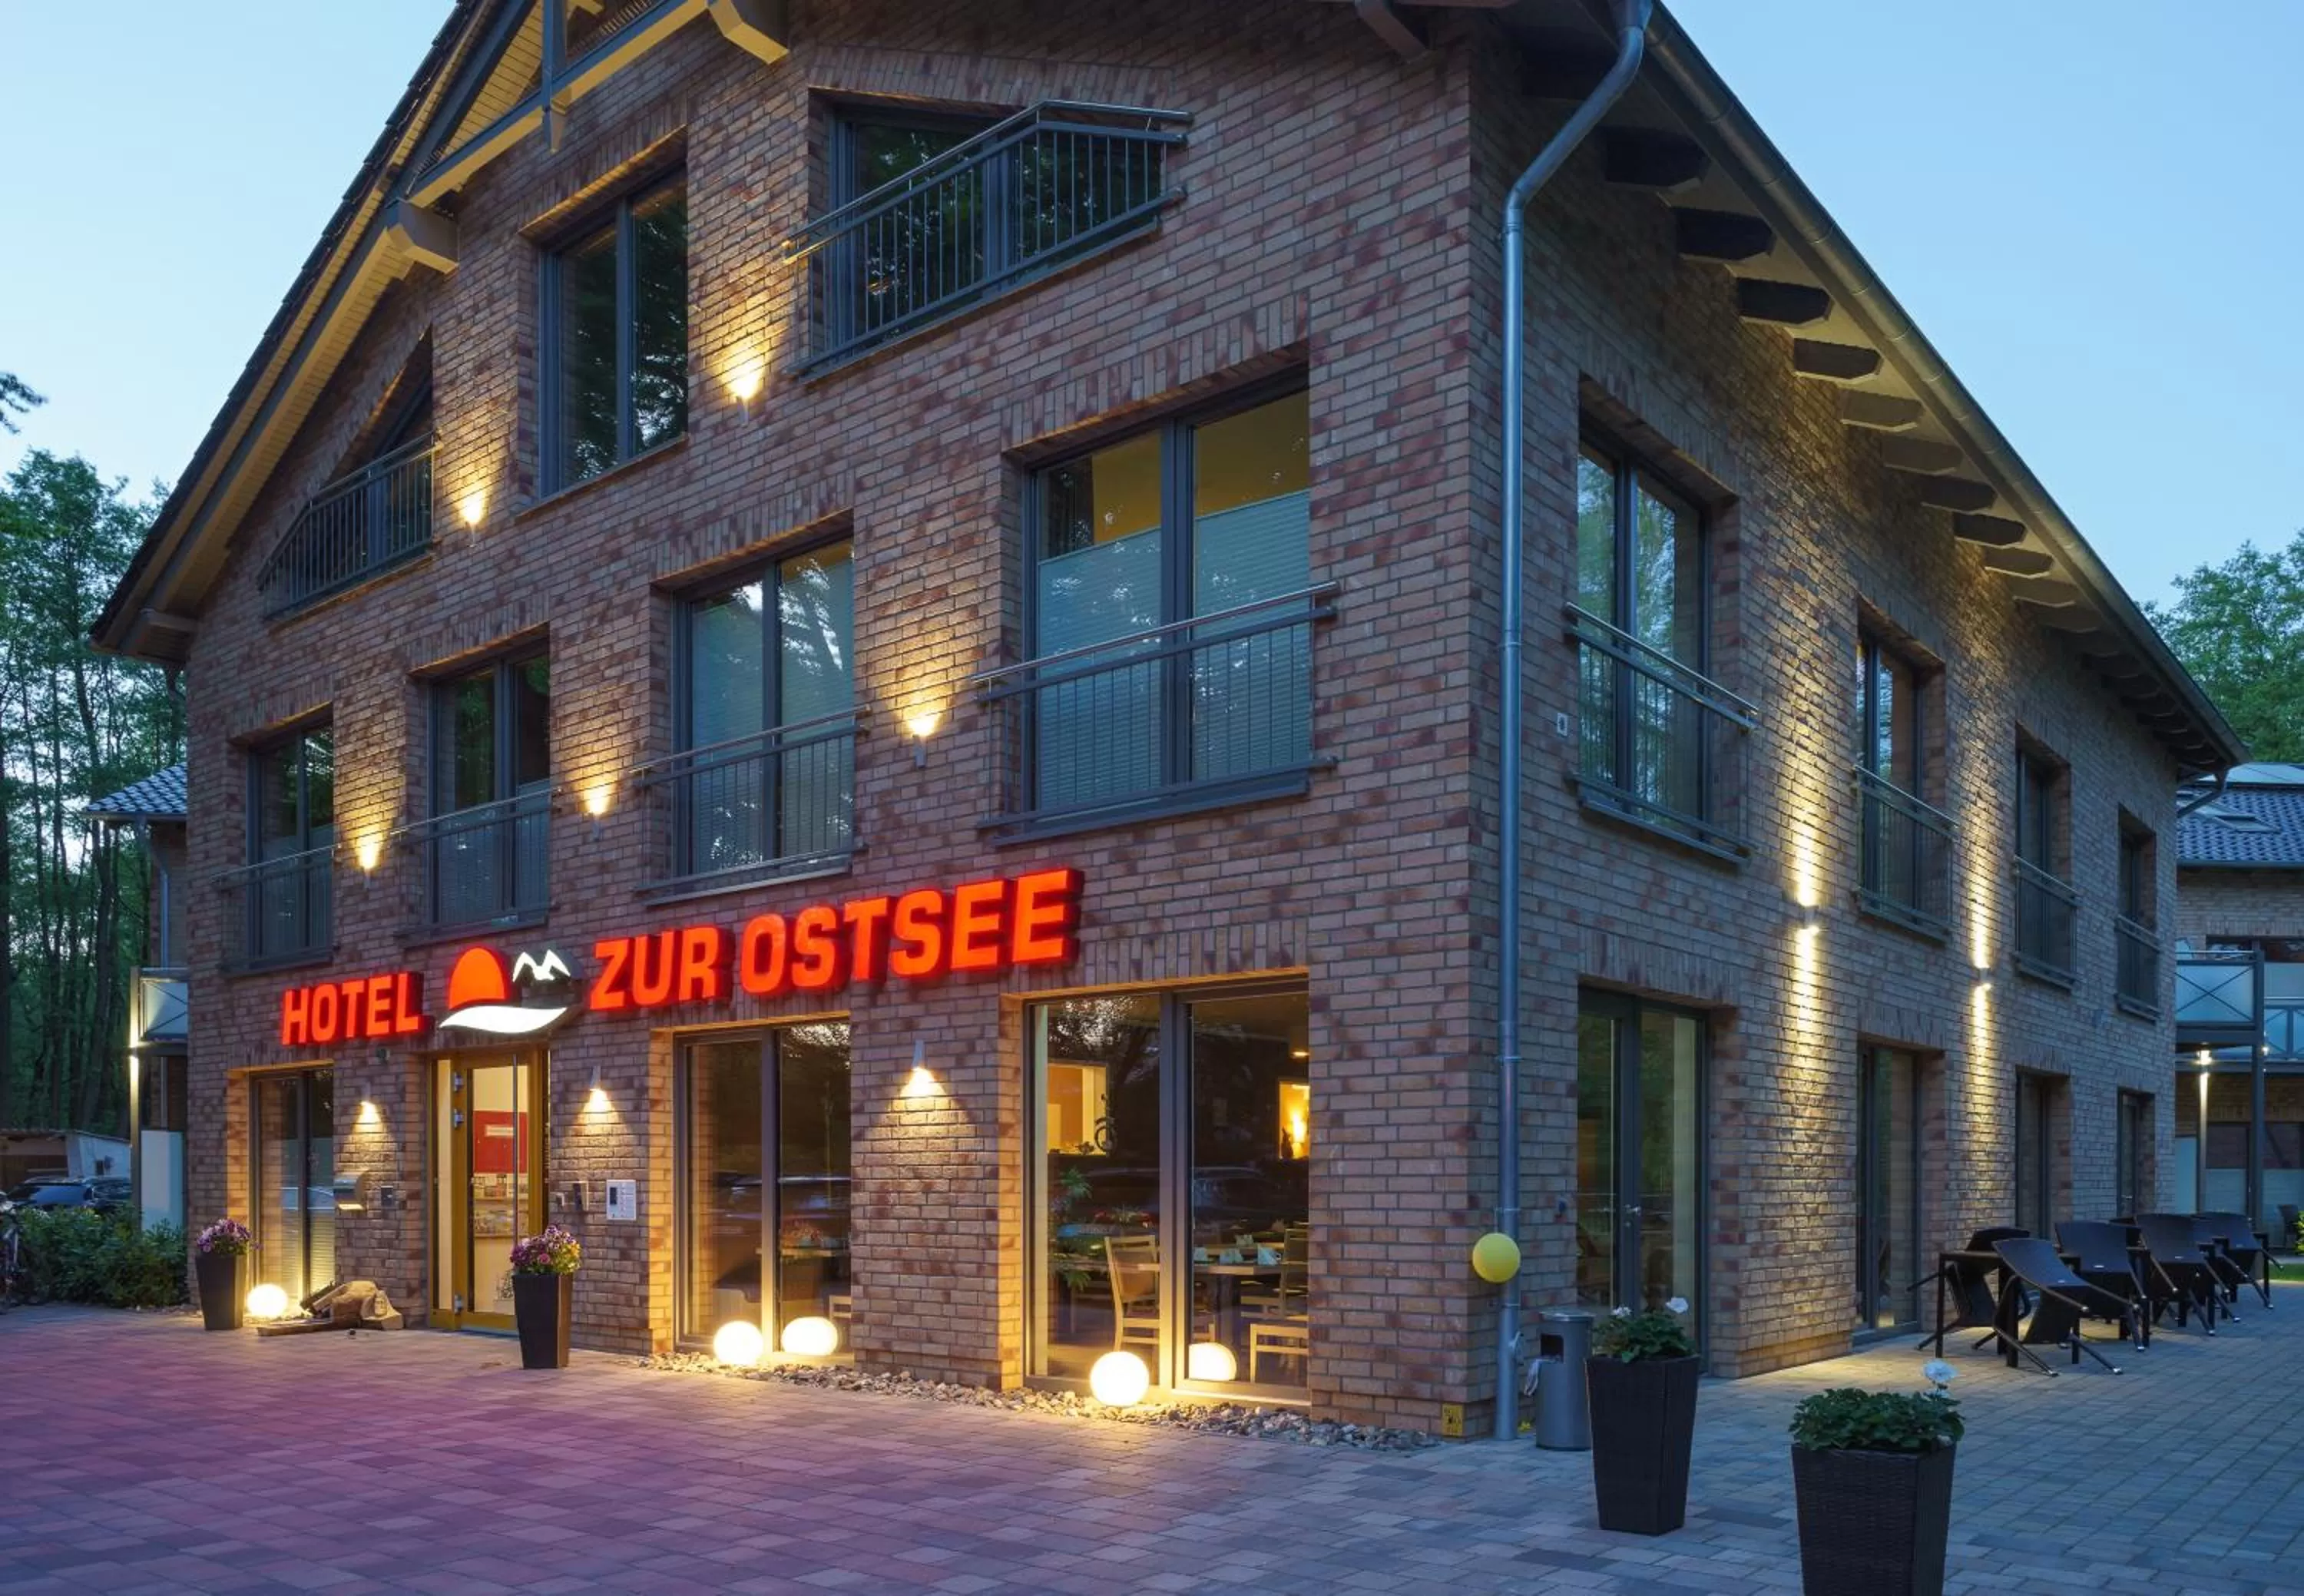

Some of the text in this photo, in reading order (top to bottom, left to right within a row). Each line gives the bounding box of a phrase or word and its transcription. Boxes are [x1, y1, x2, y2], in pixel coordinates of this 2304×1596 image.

[281, 869, 1070, 1045] HOTEL ZUR OSTSEE
